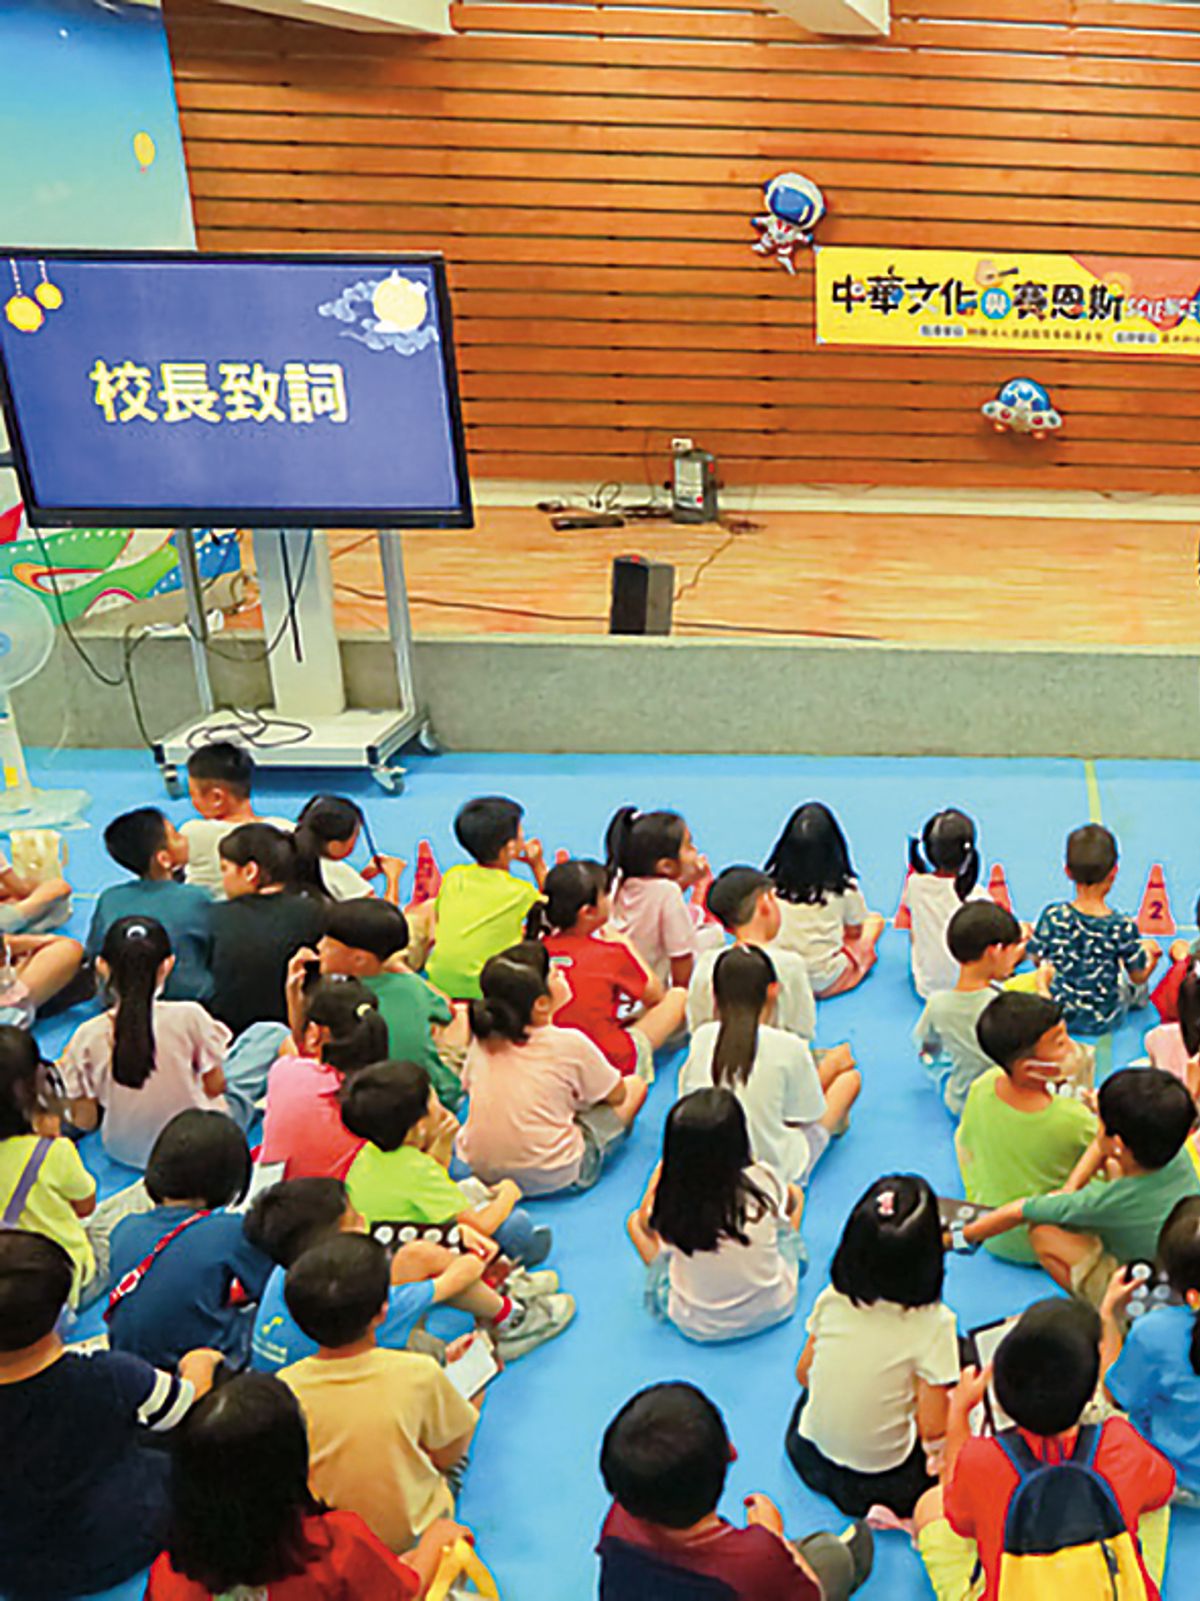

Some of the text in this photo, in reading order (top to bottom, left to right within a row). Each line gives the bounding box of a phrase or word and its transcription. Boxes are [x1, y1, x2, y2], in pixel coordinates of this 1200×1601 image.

[89, 359, 349, 424] 校長致詞
[1149, 901, 1164, 920] 2
